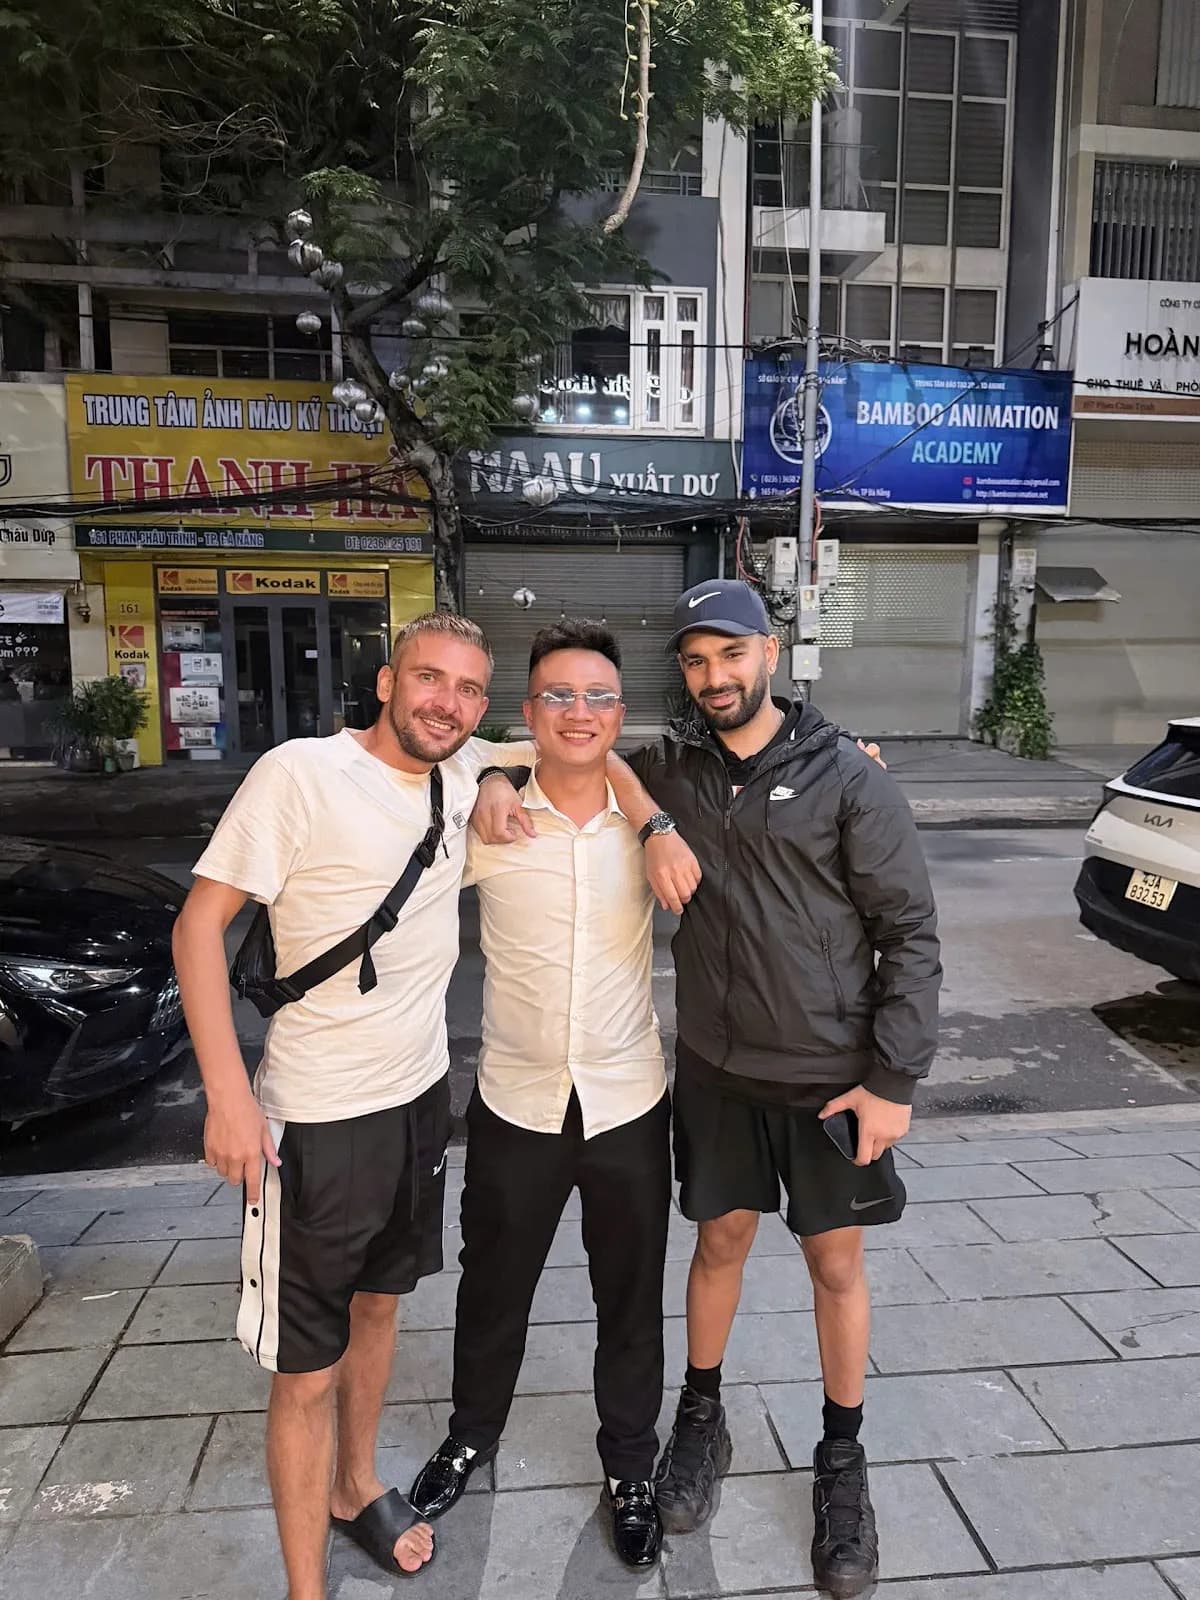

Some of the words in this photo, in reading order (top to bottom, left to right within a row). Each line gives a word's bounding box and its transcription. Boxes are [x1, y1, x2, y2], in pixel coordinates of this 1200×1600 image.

[1182, 300, 1192, 309] TY
[1126, 327, 1200, 356] HOÀN
[1176, 380, 1200, 392] PHÒ
[83, 394, 150, 426] TRUNG
[153, 390, 198, 428] TÂM
[202, 388, 244, 429] ẢNH
[248, 393, 292, 431] MÀU
[296, 395, 321, 431] KỸ
[856, 400, 944, 426] BAMBOO
[947, 403, 1059, 430] ANIMATION
[912, 441, 1002, 464] ACADEMY
[85, 455, 314, 518] THANH
[609, 462, 675, 495] XUẤT
[683, 472, 720, 497] DƯ
[256, 577, 316, 588] Kodak
[120, 604, 139, 613] 161
[114, 650, 150, 659] Kodak
[1144, 813, 1174, 828] KIA
[1129, 884, 1166, 907] 832.53
